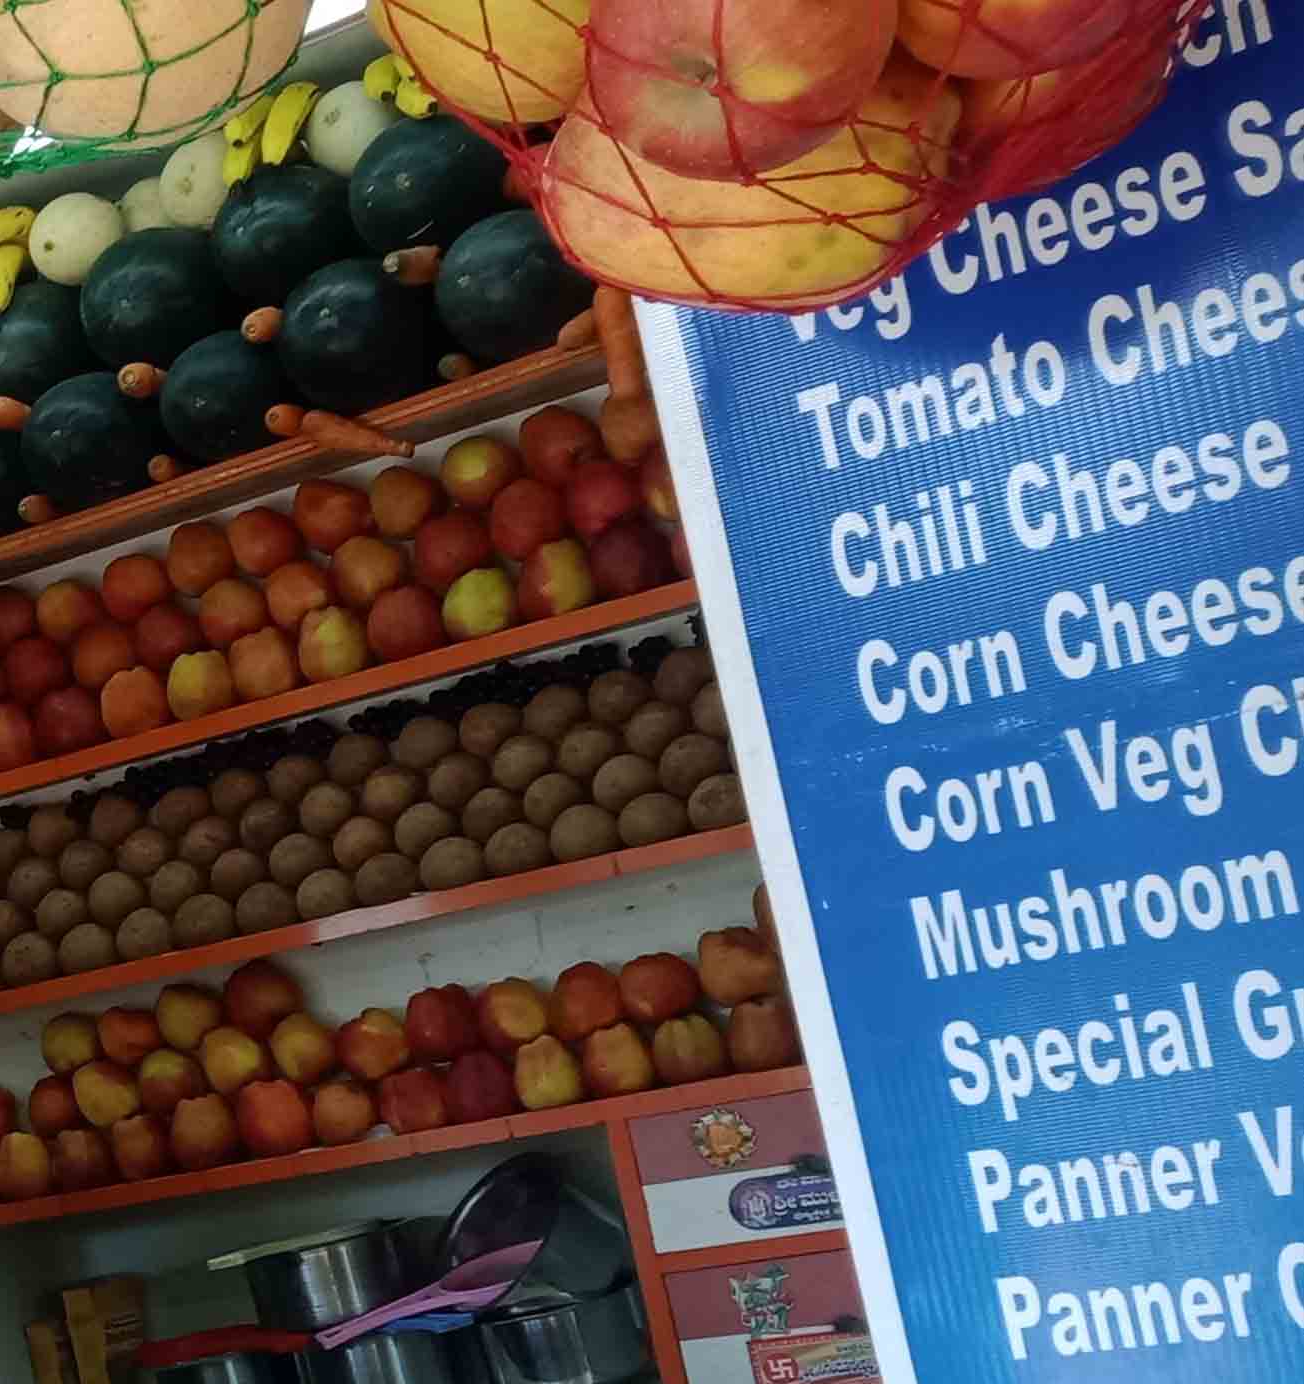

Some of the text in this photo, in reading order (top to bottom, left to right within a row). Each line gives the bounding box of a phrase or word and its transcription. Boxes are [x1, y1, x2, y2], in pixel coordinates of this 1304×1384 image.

[928, 147, 1207, 295] Cheese
[796, 332, 1067, 471] Tomato
[830, 419, 1291, 599] Chili Cheese
[856, 629, 1028, 725] Corn
[884, 674, 1304, 852] Corn Veg C
[910, 848, 1301, 980] Mushroom
[941, 982, 1214, 1122] Special
[967, 1104, 1304, 1234] Panner V
[996, 1269, 1253, 1361] Panner
